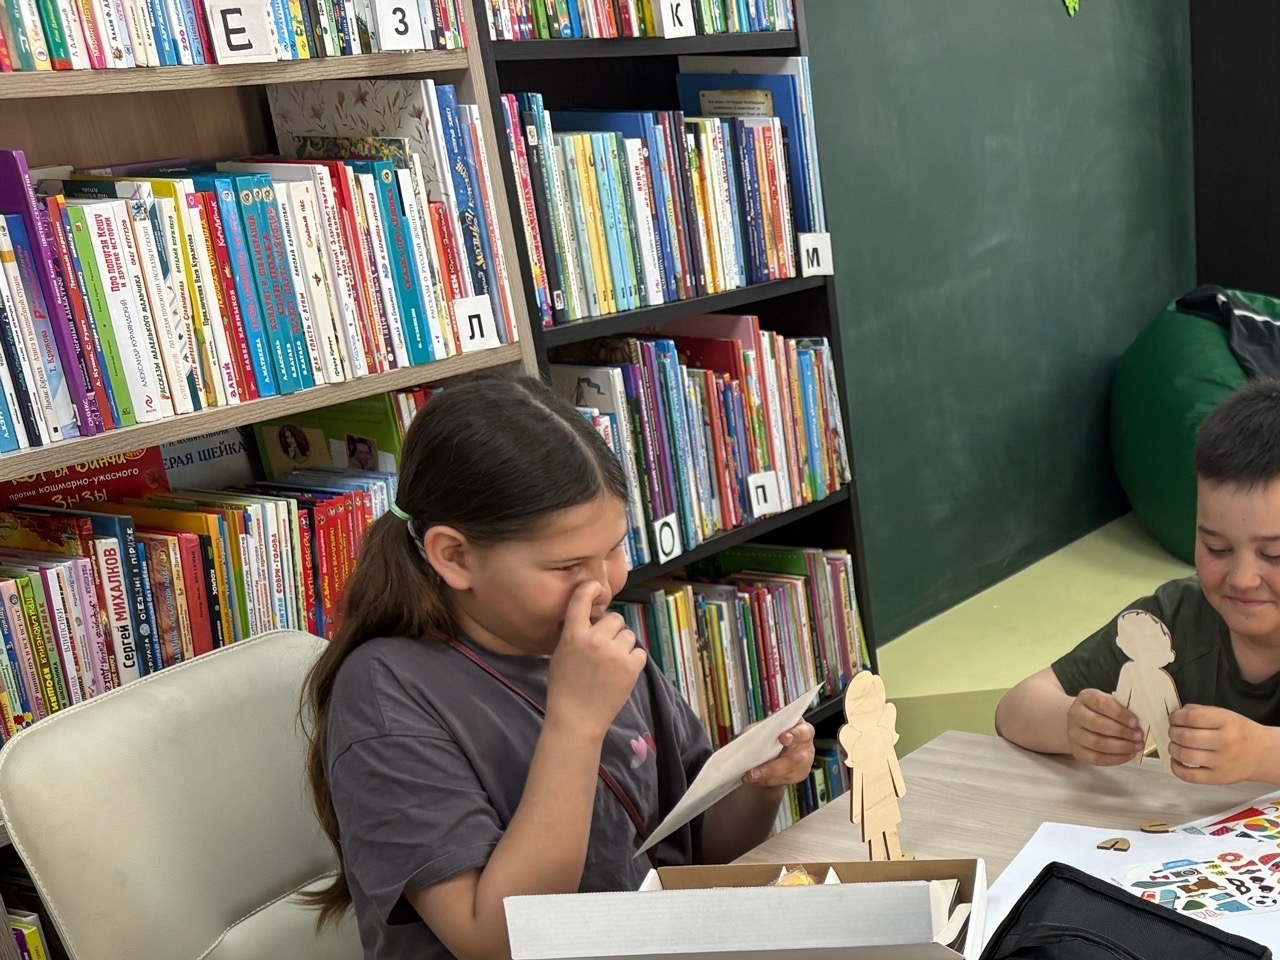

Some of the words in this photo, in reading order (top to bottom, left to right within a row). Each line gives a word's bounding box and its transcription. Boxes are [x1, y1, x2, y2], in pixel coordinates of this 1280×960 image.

[220, 8, 253, 52] Е
[669, 2, 685, 28] К
[180, 28, 191, 52] 200
[94, 213, 105, 239] Кешу
[106, 216, 121, 255] истории
[101, 239, 117, 277] попугая
[115, 255, 127, 281] другие
[187, 234, 199, 267] Куролесова
[804, 247, 822, 269] М
[110, 277, 121, 292] Про
[192, 267, 202, 284] Васи
[197, 283, 210, 327] Приключения
[467, 312, 487, 340] Л
[133, 350, 149, 388] АЛЕКСАНДР
[222, 362, 238, 399] АЛЫЙ
[163, 455, 194, 471] ЕРАЯ
[199, 440, 247, 462] ШЕЙКА
[9, 490, 37, 501] против
[38, 467, 140, 494] кошмарно-ужасного
[755, 484, 768, 507] П
[659, 521, 675, 557] О
[271, 532, 283, 594] СОВРИ-ГОЛОВА
[103, 547, 129, 622] МИХАЛКОВ
[26, 597, 48, 664] ПРИКЛЮЧЕНИЯ
[38, 602, 55, 653] С.МАРШАК
[55, 607, 71, 653] ВЛИПСИКИ
[278, 597, 287, 629] АПИТАН
[121, 624, 137, 670] Сергей
